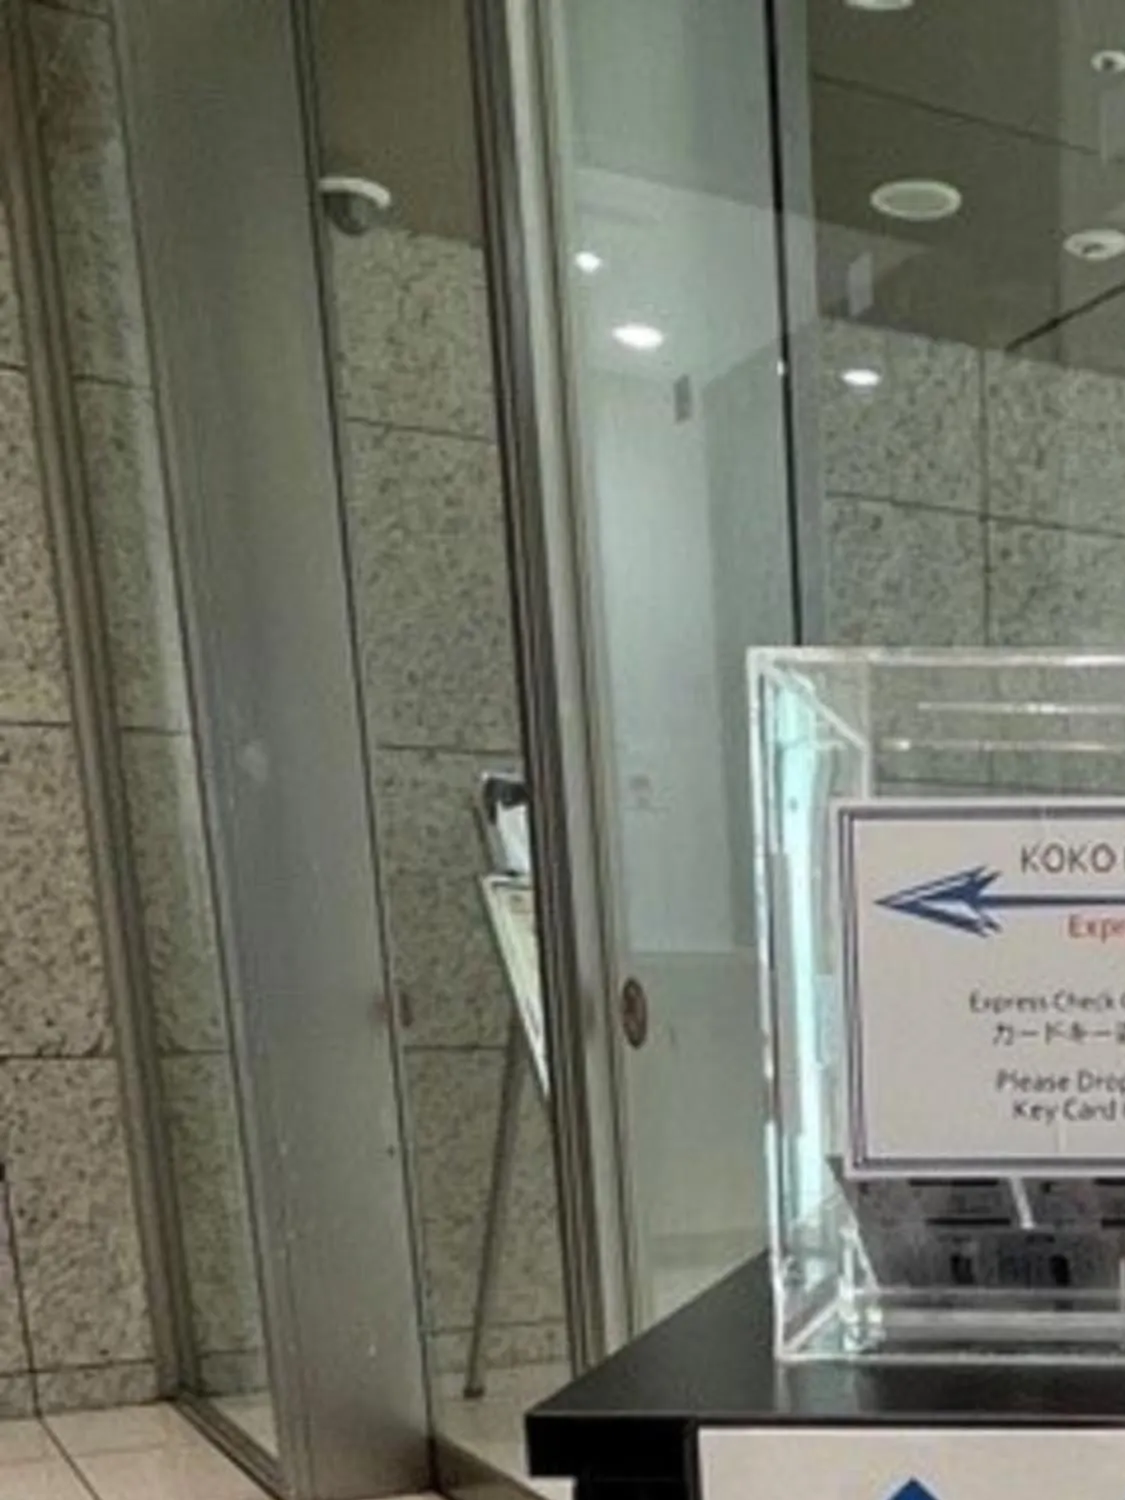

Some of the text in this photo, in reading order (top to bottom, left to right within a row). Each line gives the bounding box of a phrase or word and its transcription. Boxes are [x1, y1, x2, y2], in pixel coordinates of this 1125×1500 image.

[1020, 843, 1117, 873] KOKO
[969, 990, 1047, 1014] Express
[1053, 990, 1113, 1012] Check
[996, 1069, 1070, 1093] Please
[1012, 1099, 1056, 1125] Key
[1062, 1098, 1117, 1121] Card
